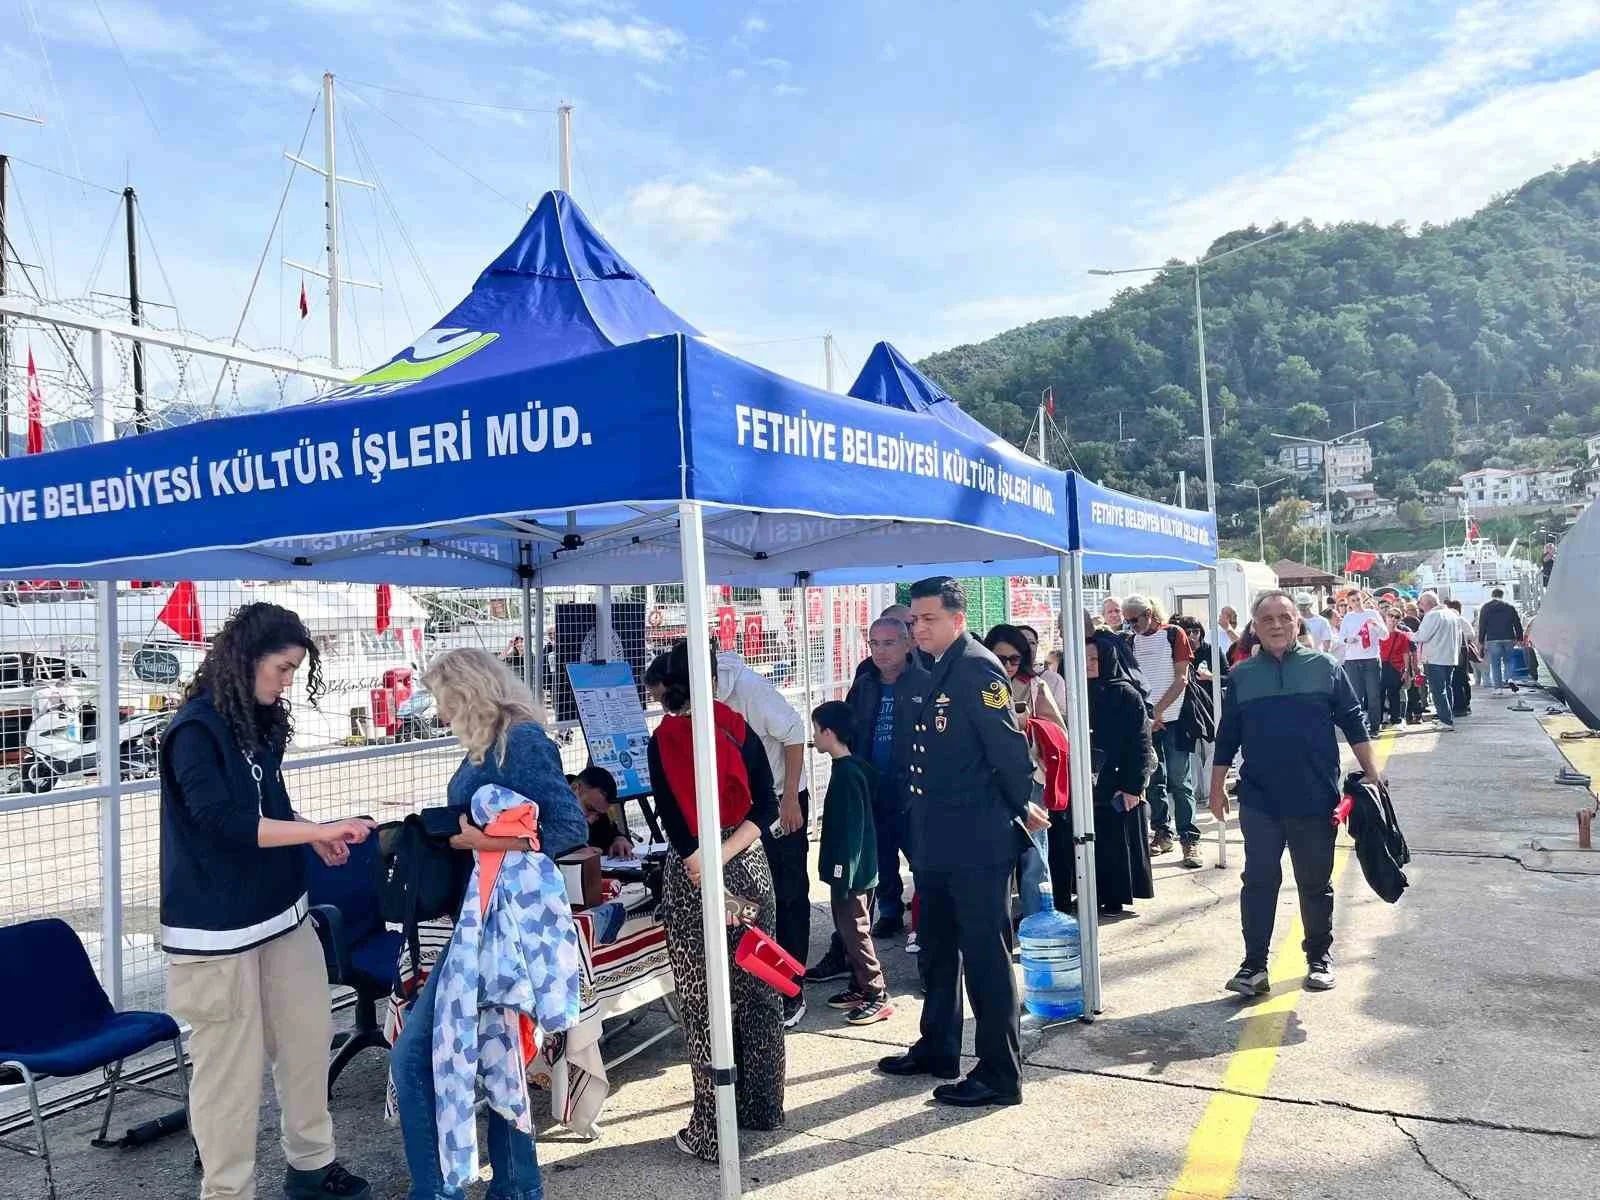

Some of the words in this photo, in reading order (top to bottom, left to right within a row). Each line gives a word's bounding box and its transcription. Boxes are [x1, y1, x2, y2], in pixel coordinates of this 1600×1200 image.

[43, 456, 202, 519] BELEDİYESİ
[209, 439, 343, 497] KÜLTÜR
[353, 410, 472, 484] İŞLERİ
[486, 400, 592, 457] MÜD.
[736, 404, 836, 461] FETHİYE
[843, 428, 938, 478] BELEDİYESİ
[942, 449, 996, 494] KÜLTÜR
[997, 463, 1032, 505] İŞLERİ
